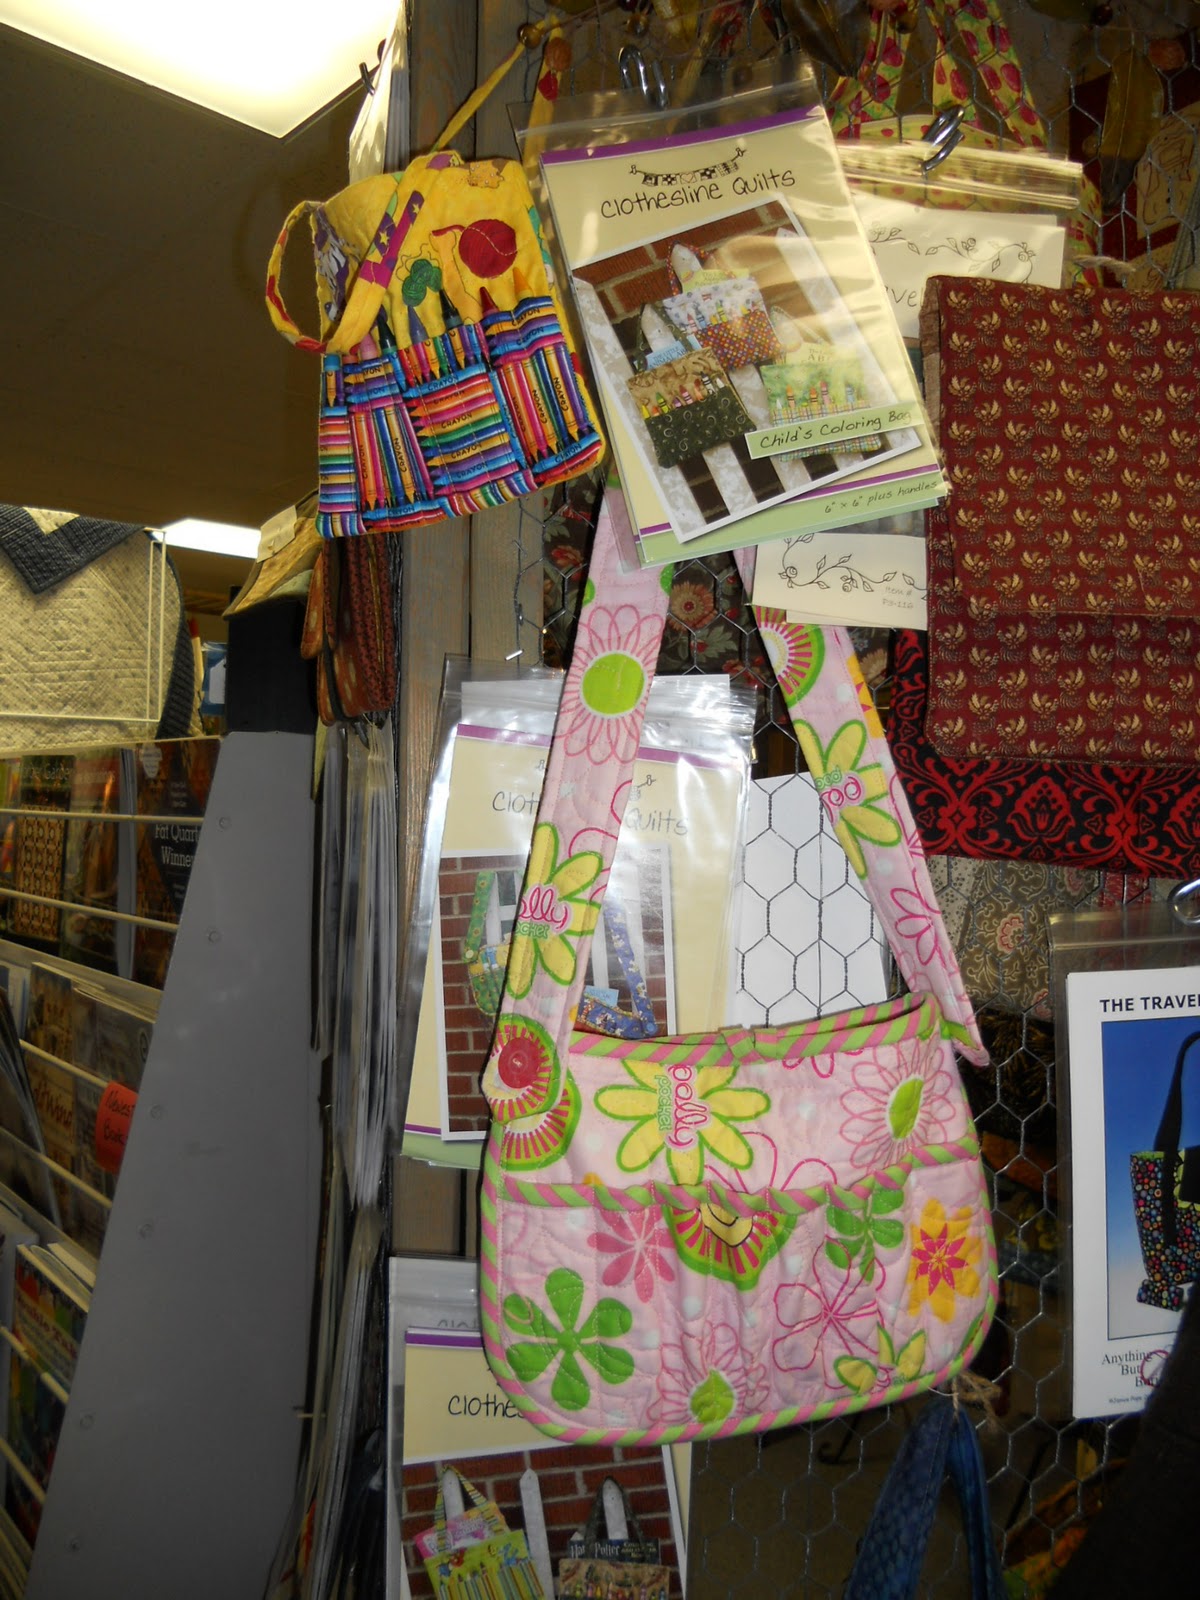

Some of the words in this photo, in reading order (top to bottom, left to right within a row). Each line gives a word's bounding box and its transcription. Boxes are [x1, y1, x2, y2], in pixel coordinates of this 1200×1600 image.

[601, 182, 723, 219] Clothesline
[732, 169, 796, 196] Quilts
[441, 413, 473, 429] CRAYON
[760, 426, 813, 449] Child's
[820, 416, 881, 437] Coloring
[888, 410, 912, 425] Bag
[867, 490, 893, 507] plus
[897, 479, 938, 497] handles
[625, 808, 689, 836] Quilts
[1099, 998, 1134, 1012] THE
[1140, 993, 1200, 1010] TRAVE
[1102, 1348, 1153, 1367] Anything
[1121, 1364, 1142, 1376] But
